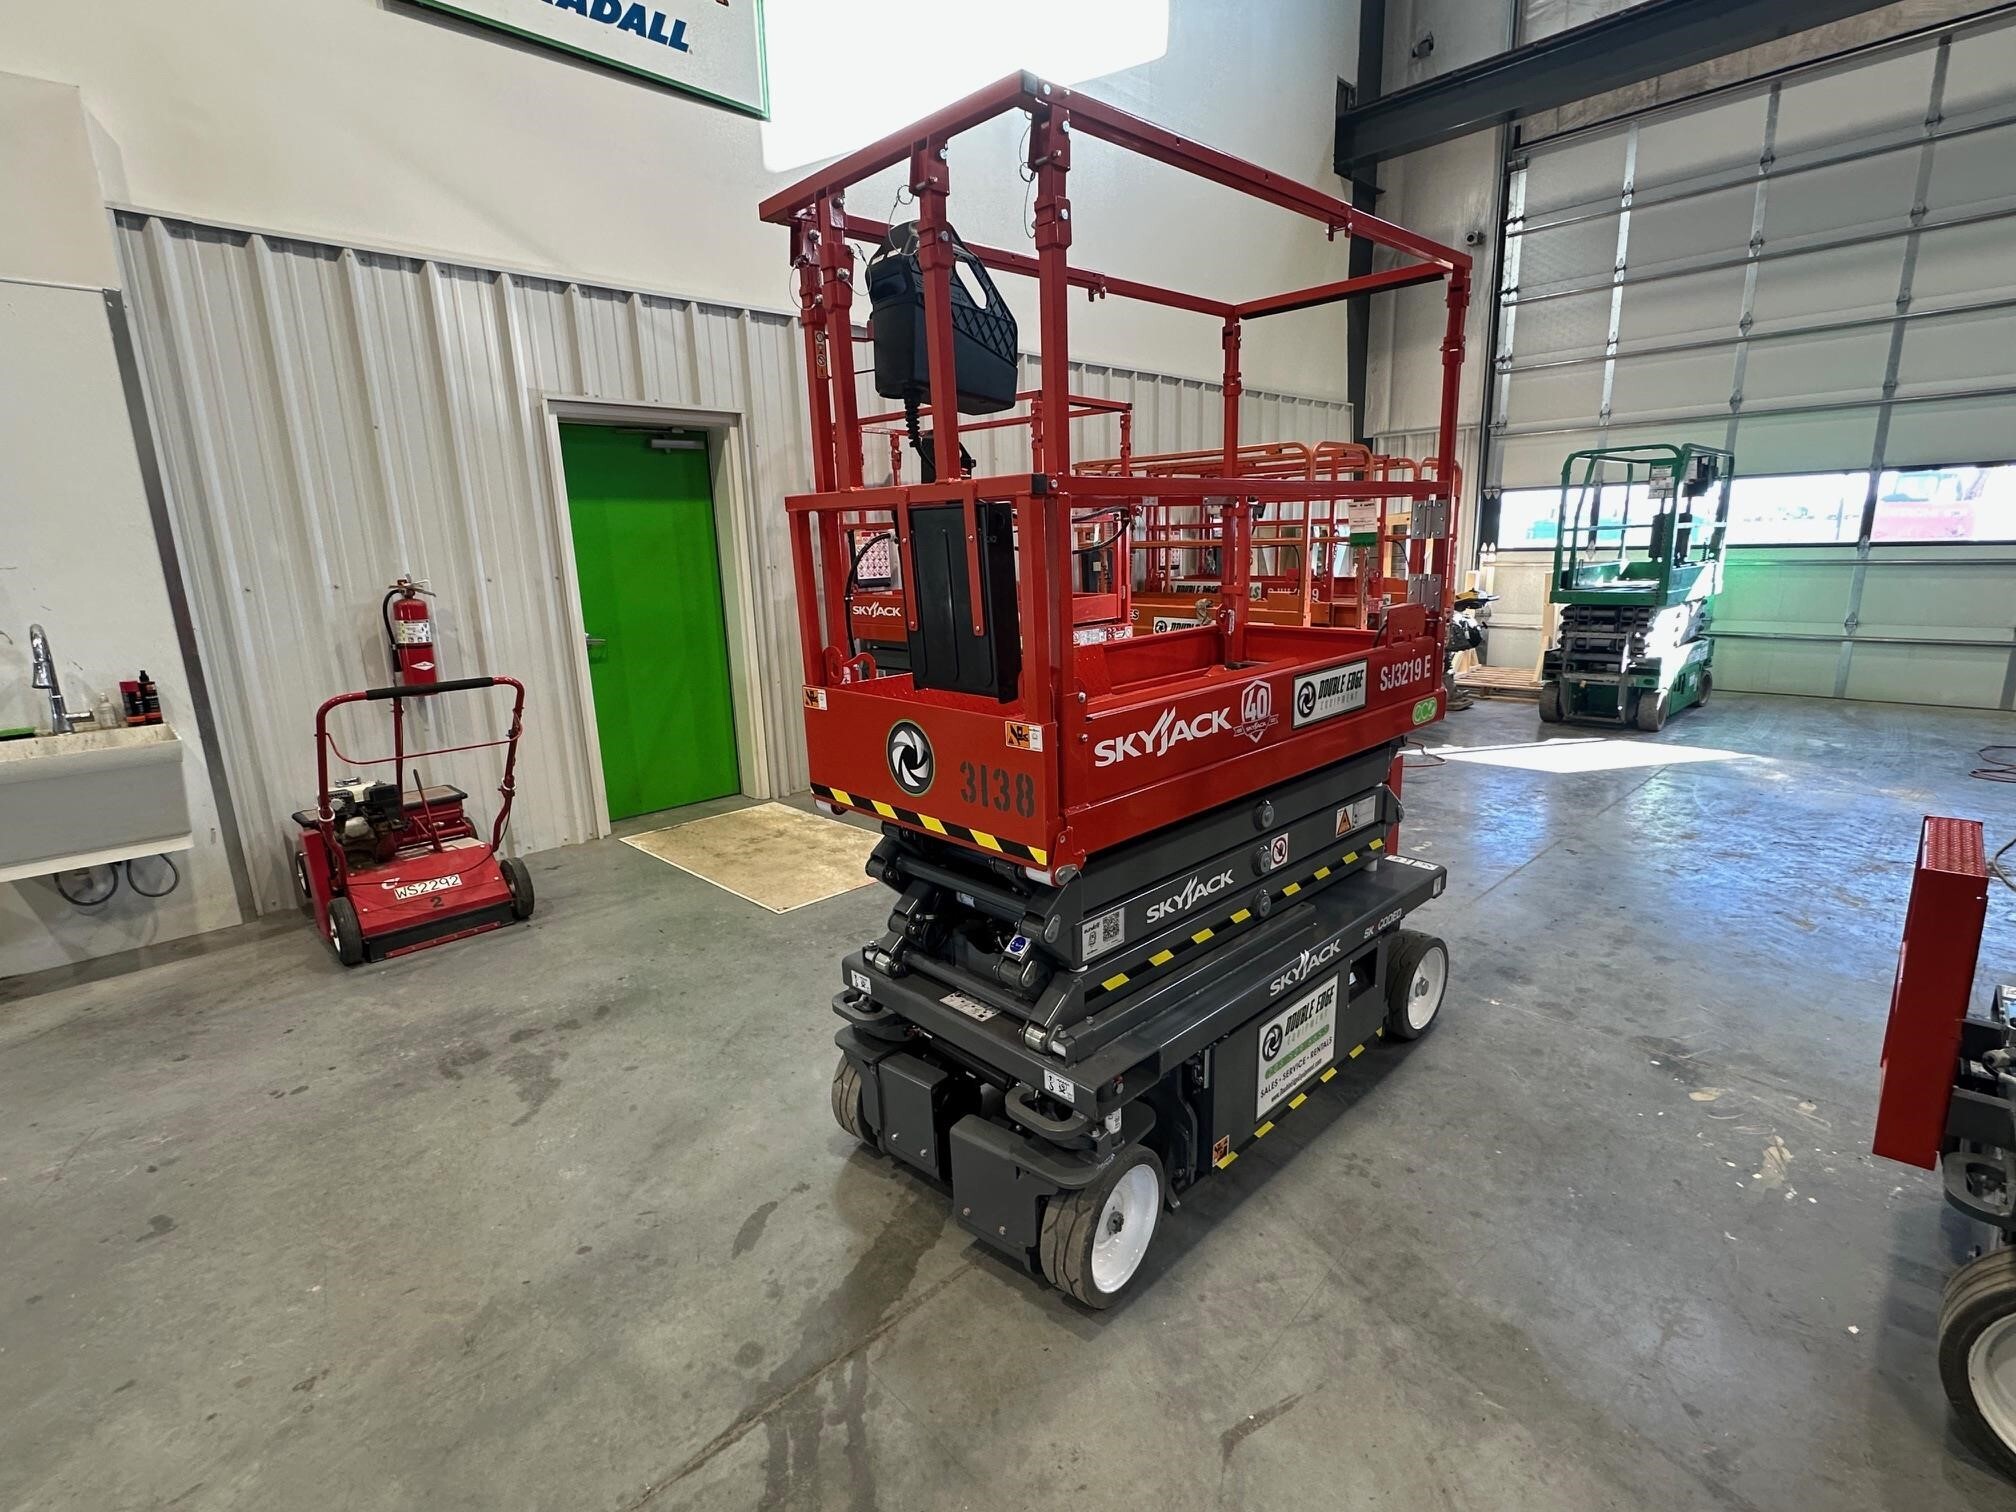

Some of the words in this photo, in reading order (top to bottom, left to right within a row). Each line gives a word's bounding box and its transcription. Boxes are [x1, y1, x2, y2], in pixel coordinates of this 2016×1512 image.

[852, 601, 901, 618] SKYJACK
[1317, 674, 1347, 700] DOUBLE
[1346, 669, 1365, 692] EDGE
[1380, 657, 1422, 692] SJ3219
[1424, 654, 1432, 679] E
[1244, 687, 1268, 720] 40
[1095, 706, 1232, 767] SKYJACK
[960, 760, 1036, 818] 3138
[395, 875, 460, 899] WS2292
[431, 895, 444, 908] 2
[1146, 869, 1235, 924] SKYJACK
[1269, 938, 1342, 997] SKYJACK
[1284, 998, 1316, 1037] DOUBLE
[1315, 984, 1336, 1014] EDGE
[1260, 1078, 1279, 1098] SALES
[1282, 1056, 1307, 1081] SERVICE
[1309, 1036, 1334, 1060] RENTALS
